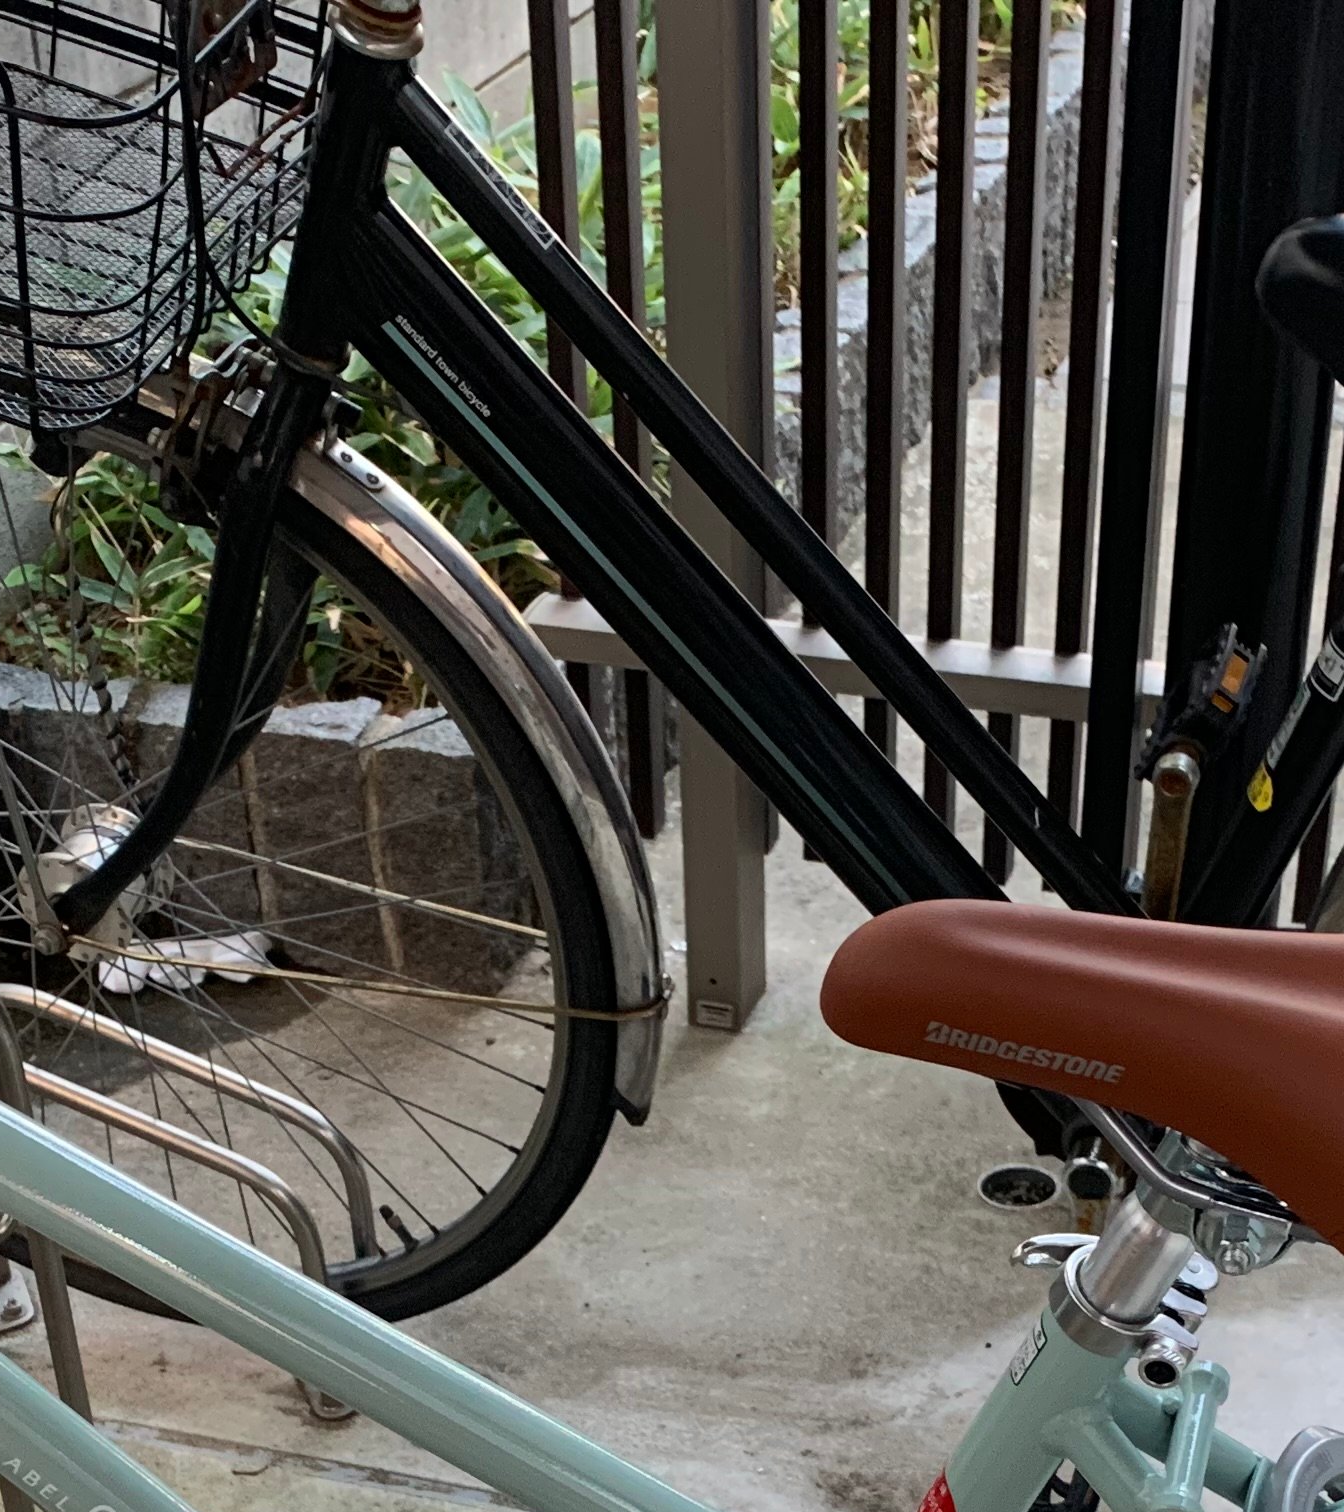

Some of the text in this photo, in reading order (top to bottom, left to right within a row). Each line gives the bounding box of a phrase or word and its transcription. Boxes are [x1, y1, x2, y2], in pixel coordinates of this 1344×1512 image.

[395, 314, 491, 417] standard town bicycle
[924, 1021, 1126, 1083] BRIDGESTONE
